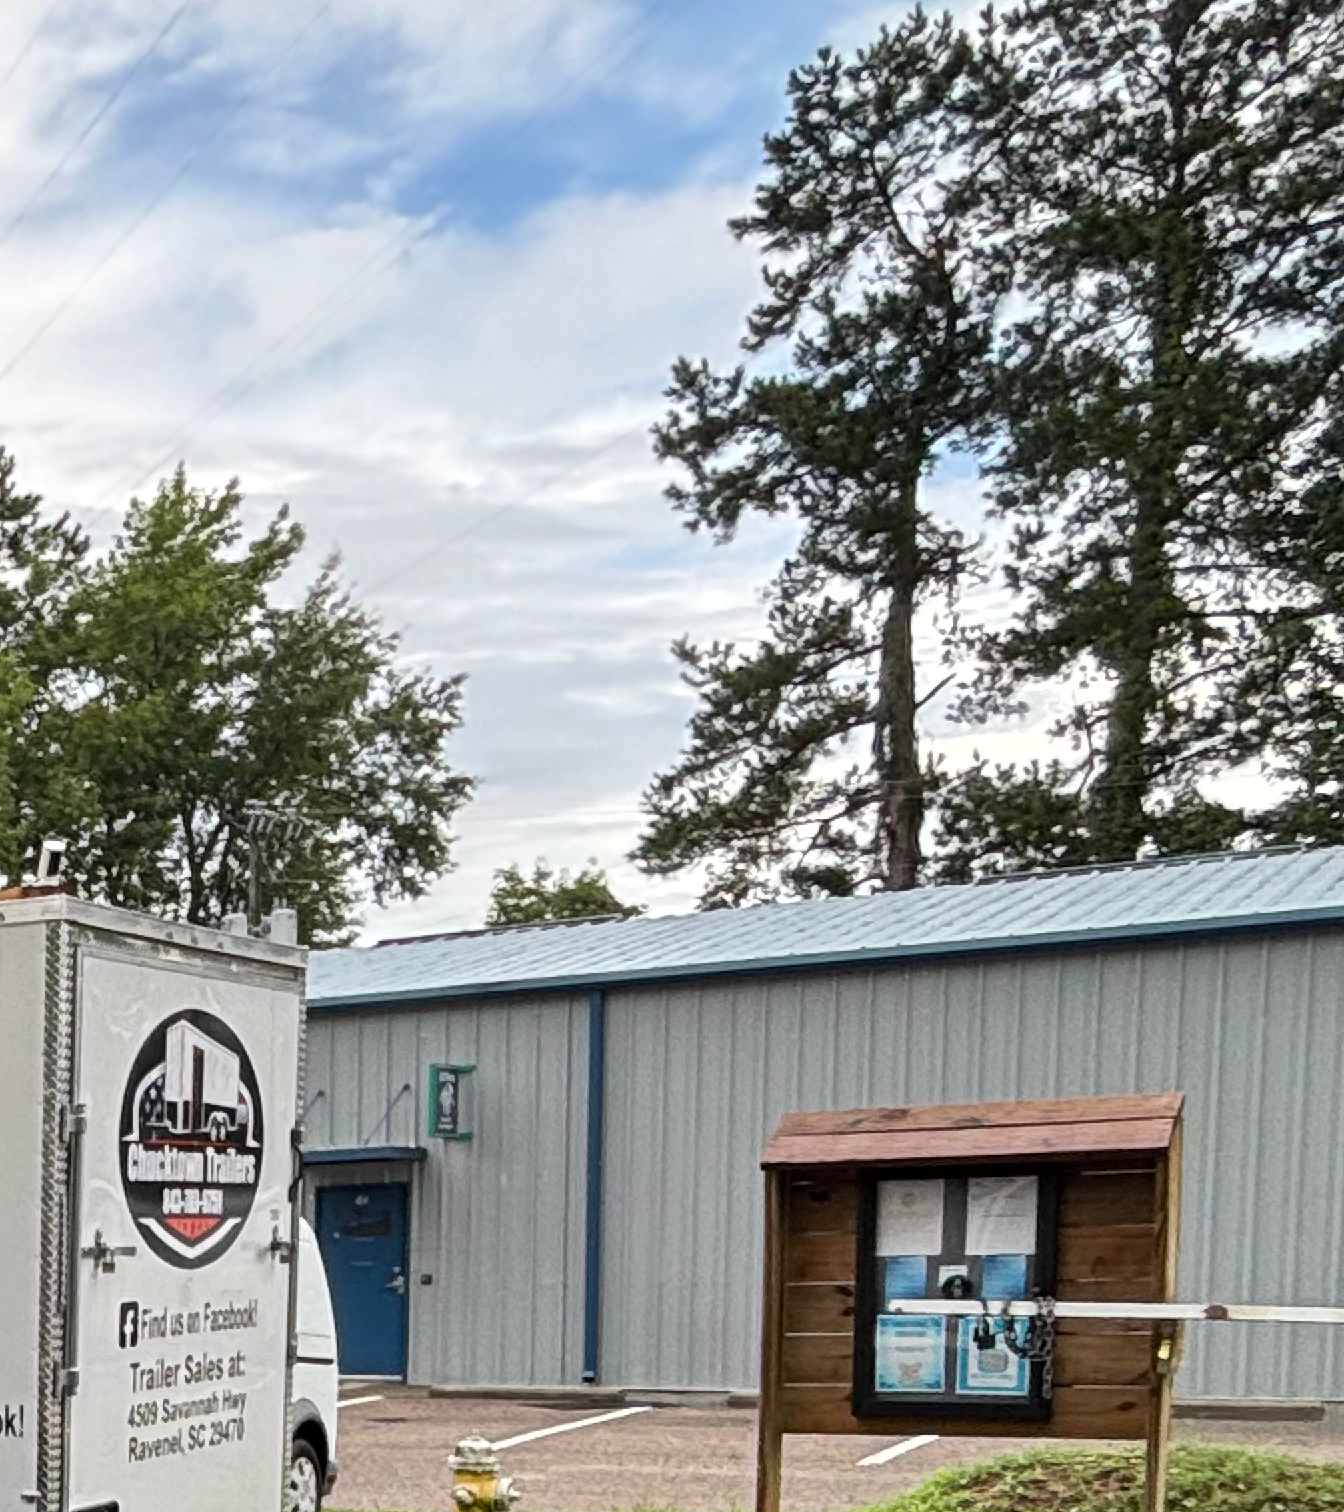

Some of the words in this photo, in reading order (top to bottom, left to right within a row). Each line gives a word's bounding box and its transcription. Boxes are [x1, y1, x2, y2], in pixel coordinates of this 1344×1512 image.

[141, 1306, 168, 1340] Find
[170, 1311, 184, 1337] us
[187, 1311, 200, 1334] on
[203, 1298, 258, 1333] Facebook!
[129, 1358, 181, 1393] Trailer
[184, 1352, 224, 1384] Sales
[228, 1350, 246, 1377] at:
[127, 1401, 159, 1428] 4509
[161, 1391, 220, 1423] Savannah
[222, 1389, 247, 1415] Hwy
[128, 1427, 186, 1463] Ravenel,
[188, 1423, 207, 1450] SC
[209, 1416, 245, 1446] 29470
